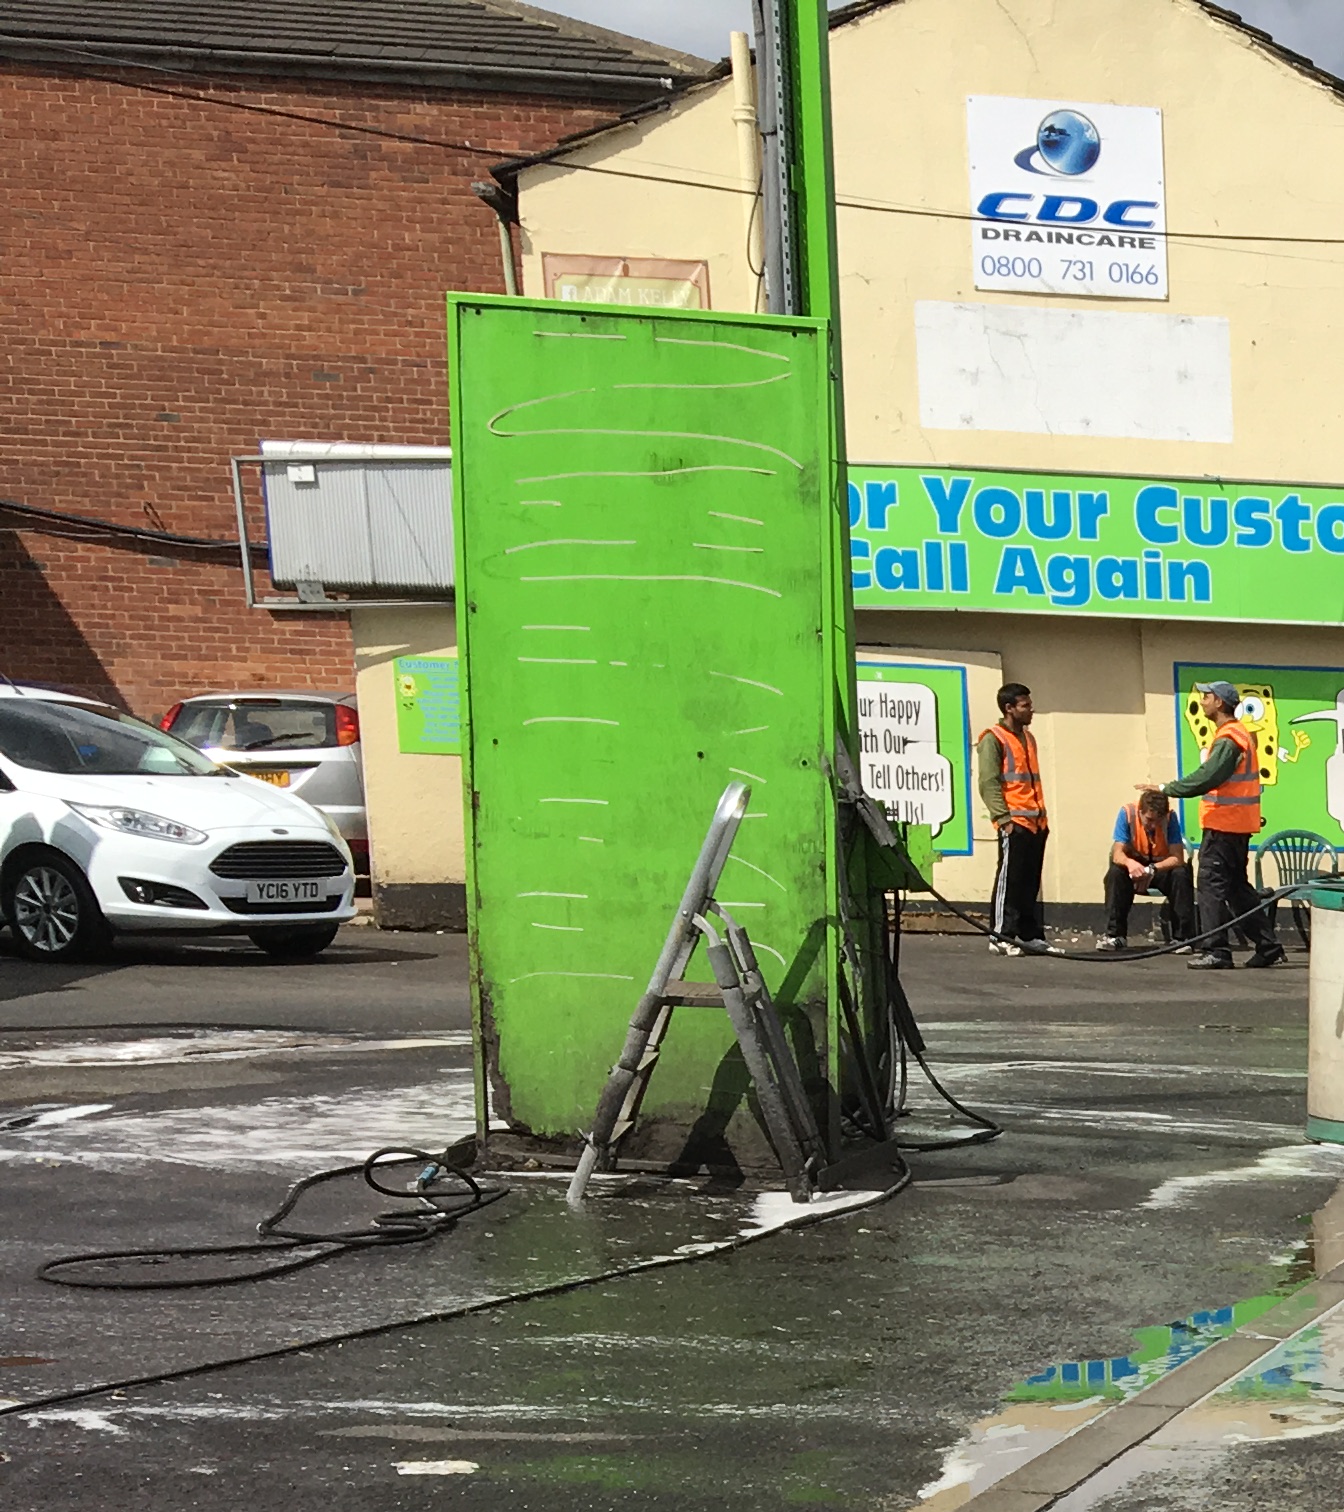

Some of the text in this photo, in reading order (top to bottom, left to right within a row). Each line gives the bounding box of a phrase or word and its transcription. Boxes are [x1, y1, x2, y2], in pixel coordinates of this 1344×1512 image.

[977, 192, 1160, 229] CDC
[981, 227, 1156, 249] DRAINCARE
[981, 255, 1159, 285] 0800 731 0166
[583, 286, 632, 304] ADAM
[641, 288, 688, 307] KELLY
[919, 475, 1110, 541] Your
[993, 545, 1212, 606] Again
[399, 659, 449, 669] Customer
[879, 692, 921, 726] Happy
[859, 729, 908, 754] ith Our
[869, 764, 945, 792] Tell Others!
[257, 882, 319, 899] YC16 YTD
